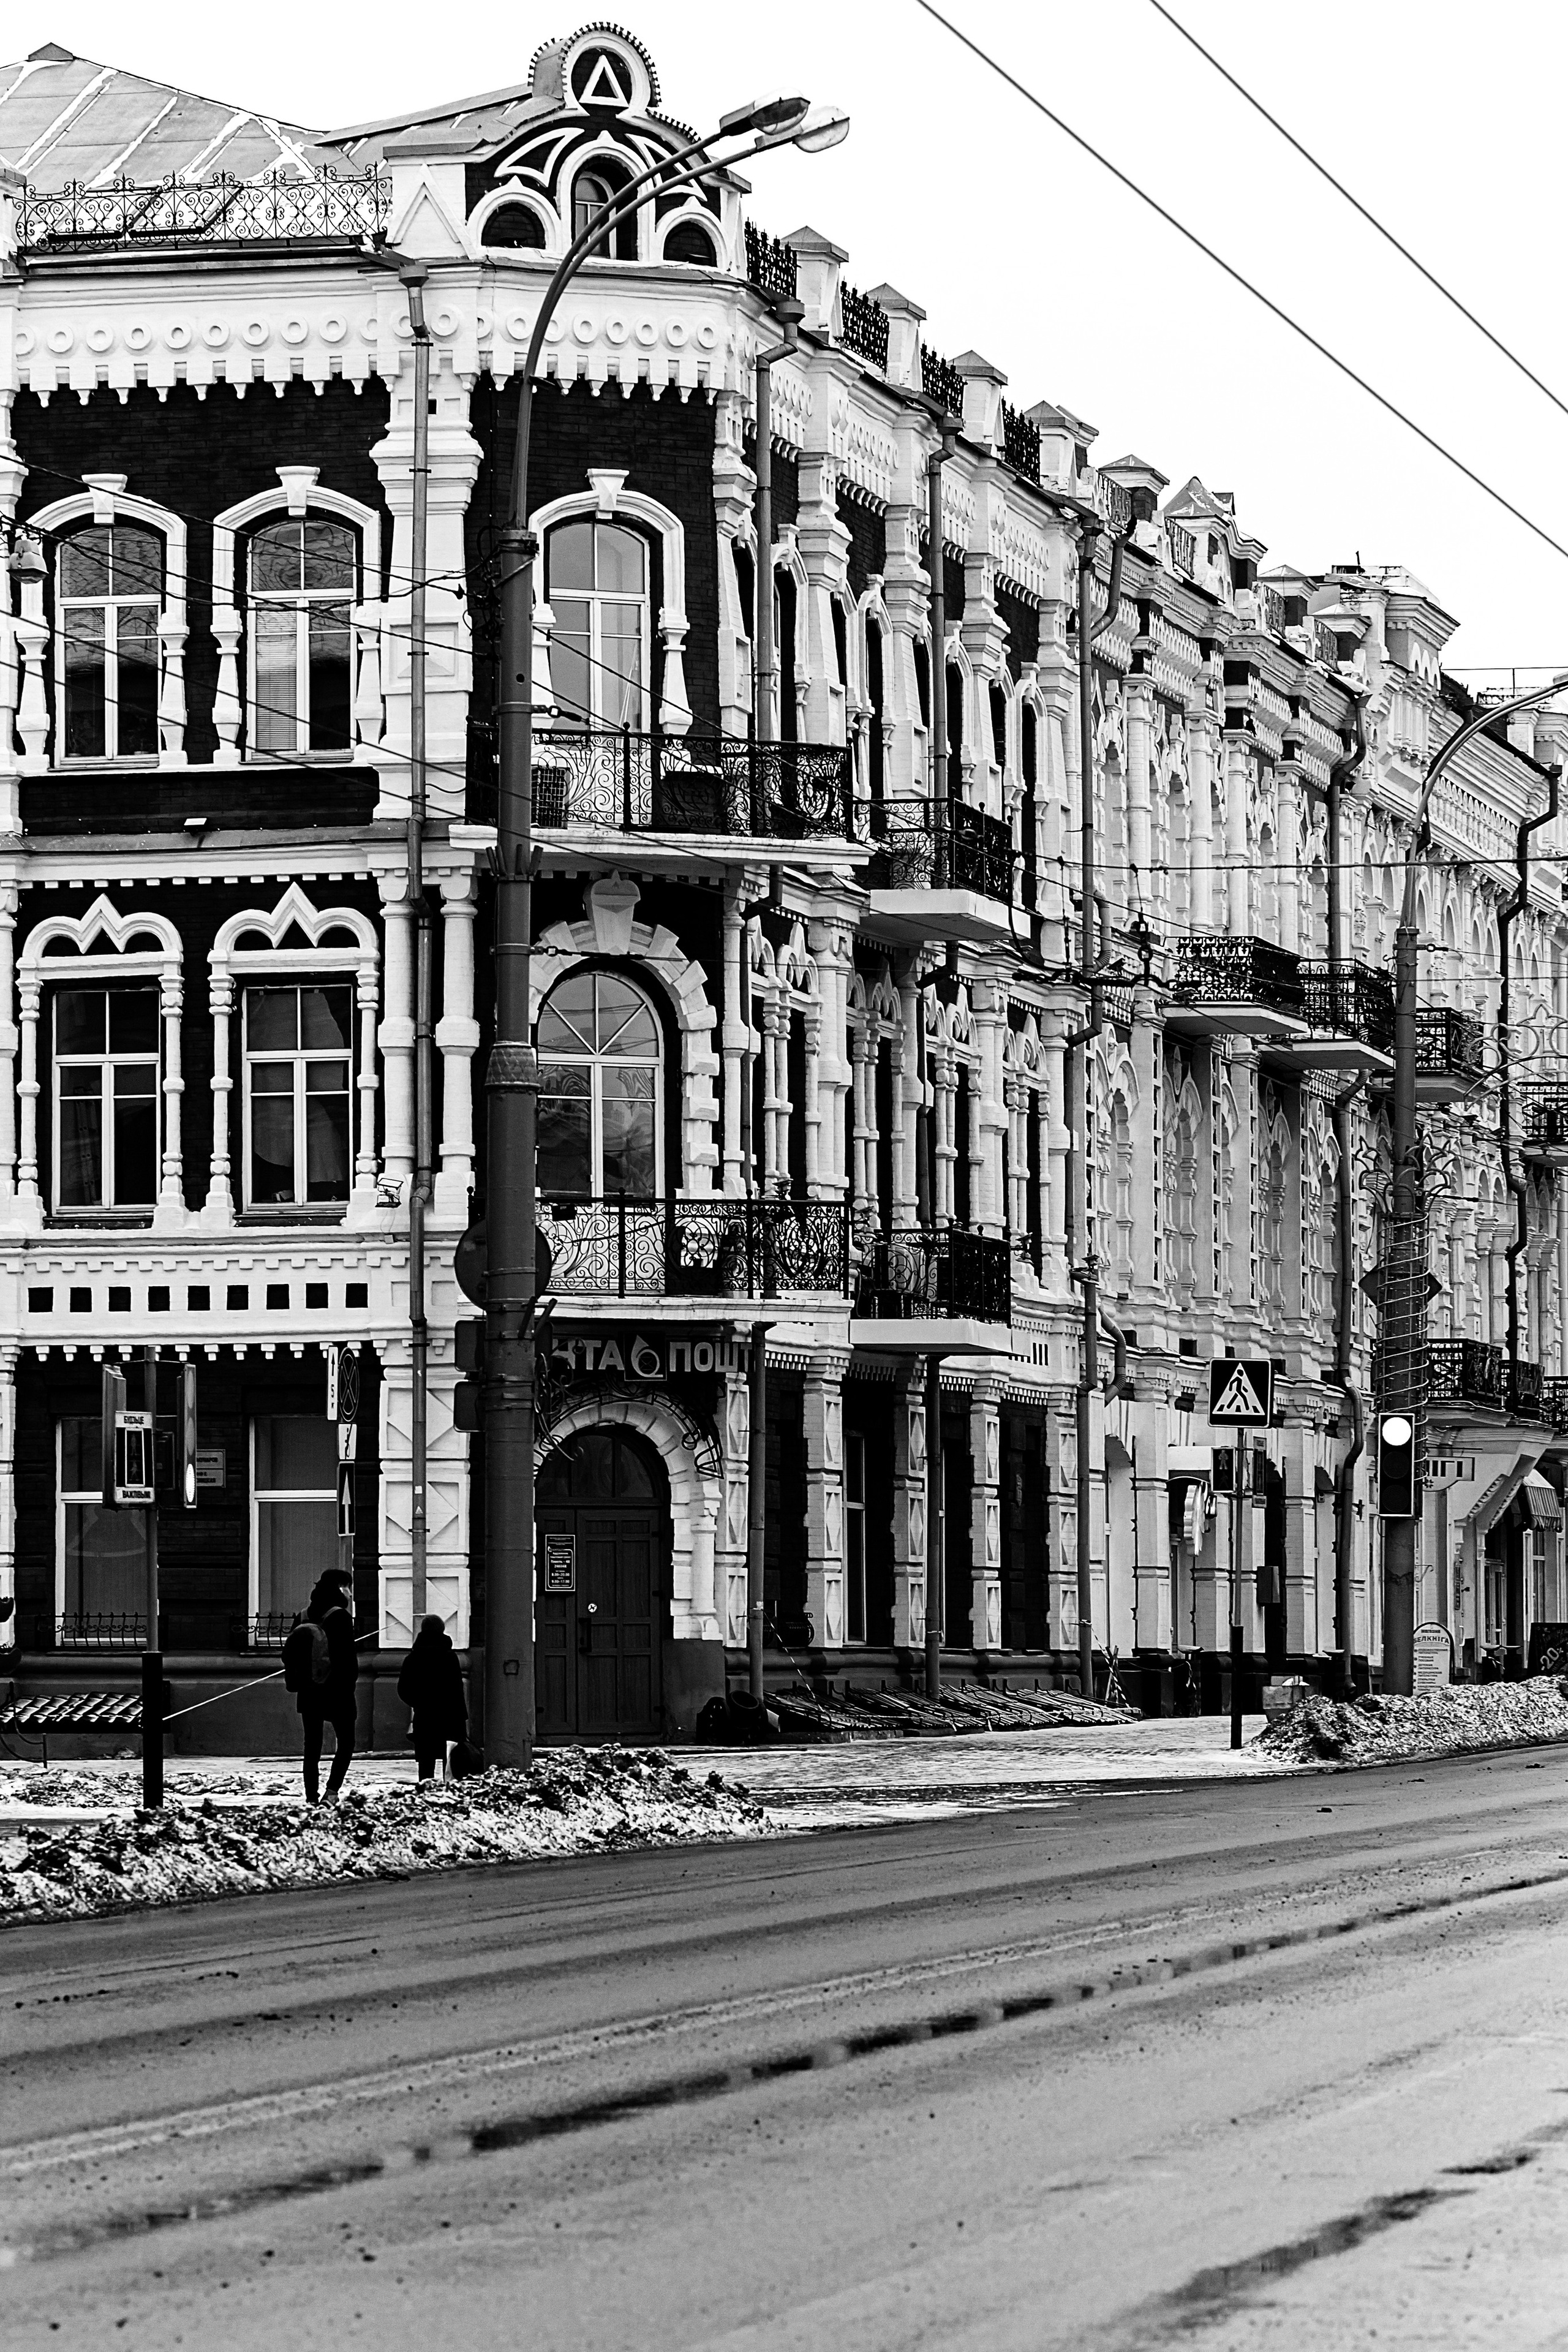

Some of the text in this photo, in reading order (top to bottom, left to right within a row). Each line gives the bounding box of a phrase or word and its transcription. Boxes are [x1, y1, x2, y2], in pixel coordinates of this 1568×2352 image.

[552, 1338, 625, 1371] ЧТА
[669, 1341, 756, 1372] ПОШТ
[331, 1384, 334, 1398] 5
[1426, 1460, 1463, 1477] ІГІ
[1540, 1647, 1564, 1670] -20%
